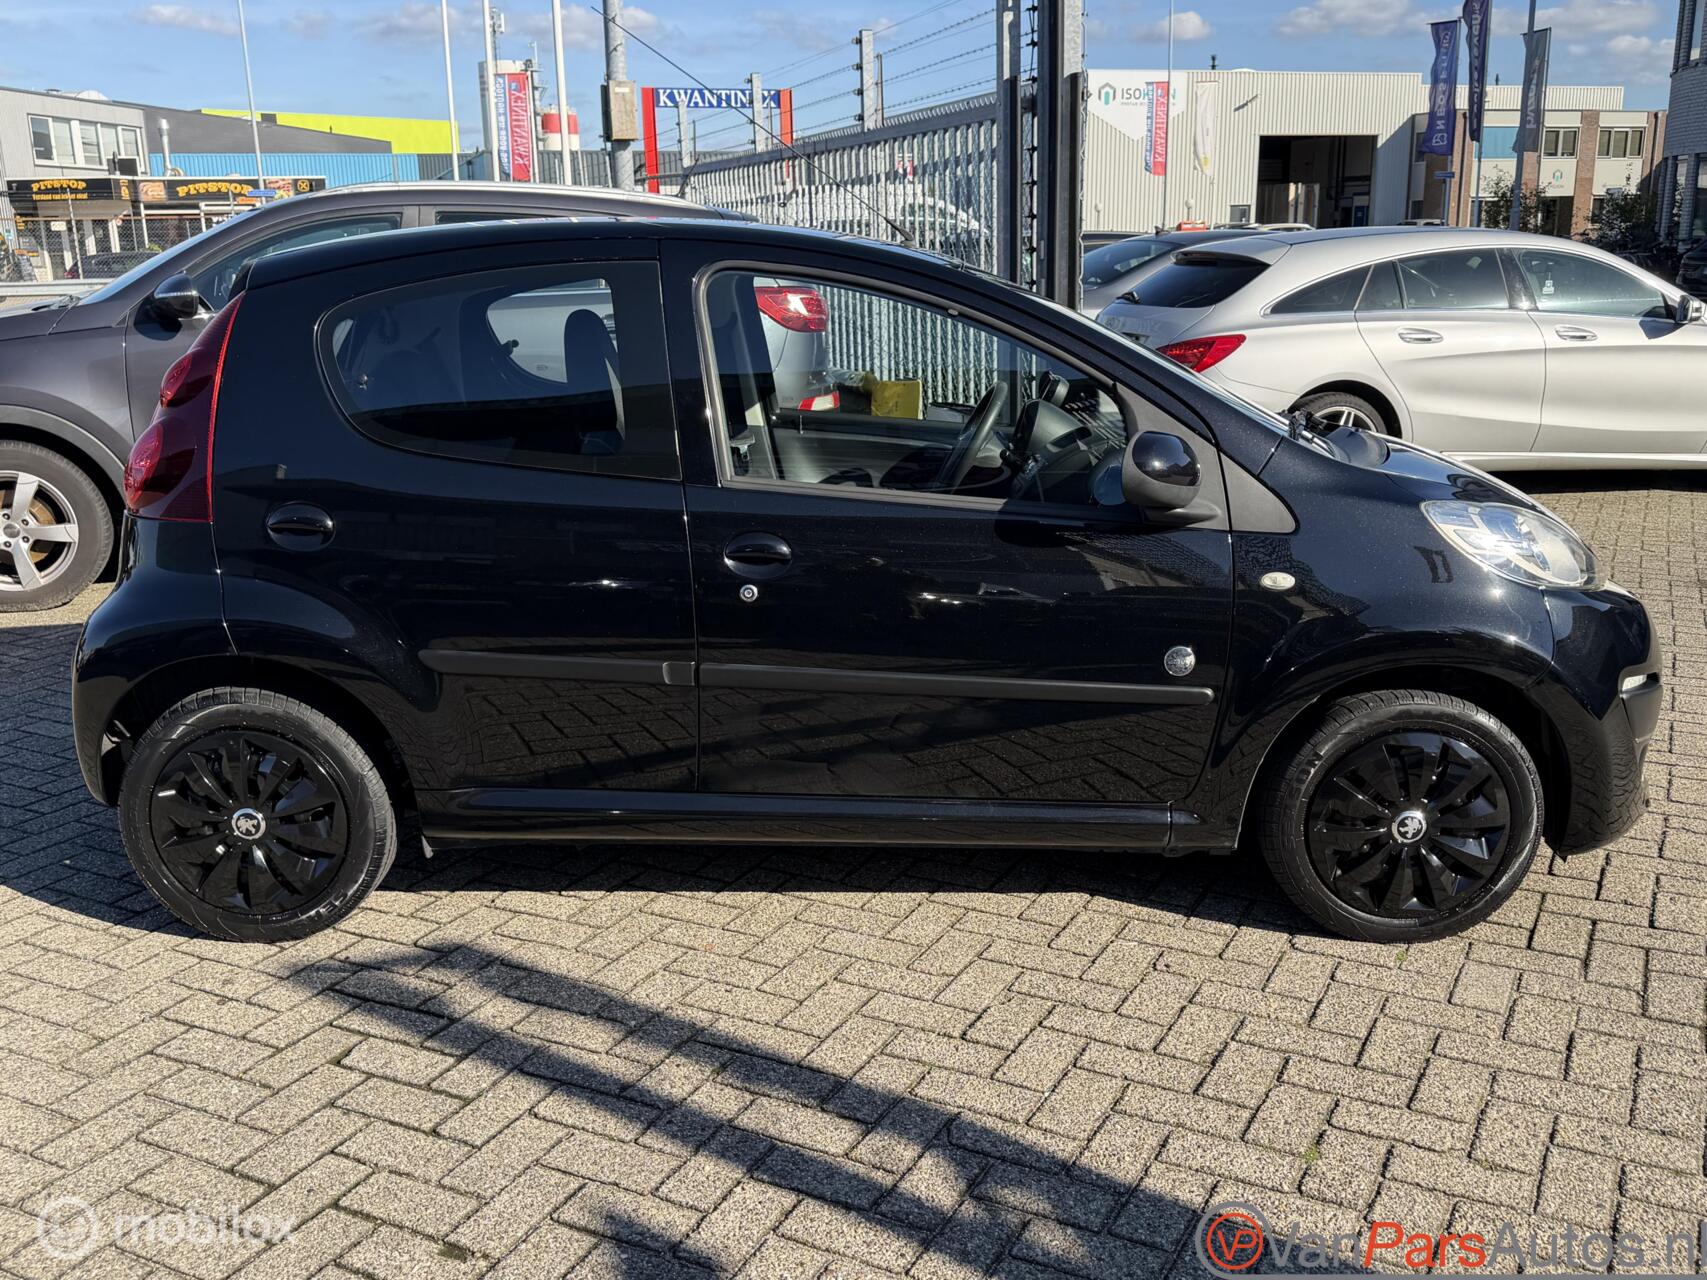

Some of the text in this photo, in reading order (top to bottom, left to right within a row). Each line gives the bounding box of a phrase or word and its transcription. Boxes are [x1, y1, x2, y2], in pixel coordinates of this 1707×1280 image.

[659, 89, 777, 107] KWANTINX
[32, 180, 87, 192] PITSTOP
[176, 182, 253, 197] PITSTOP
